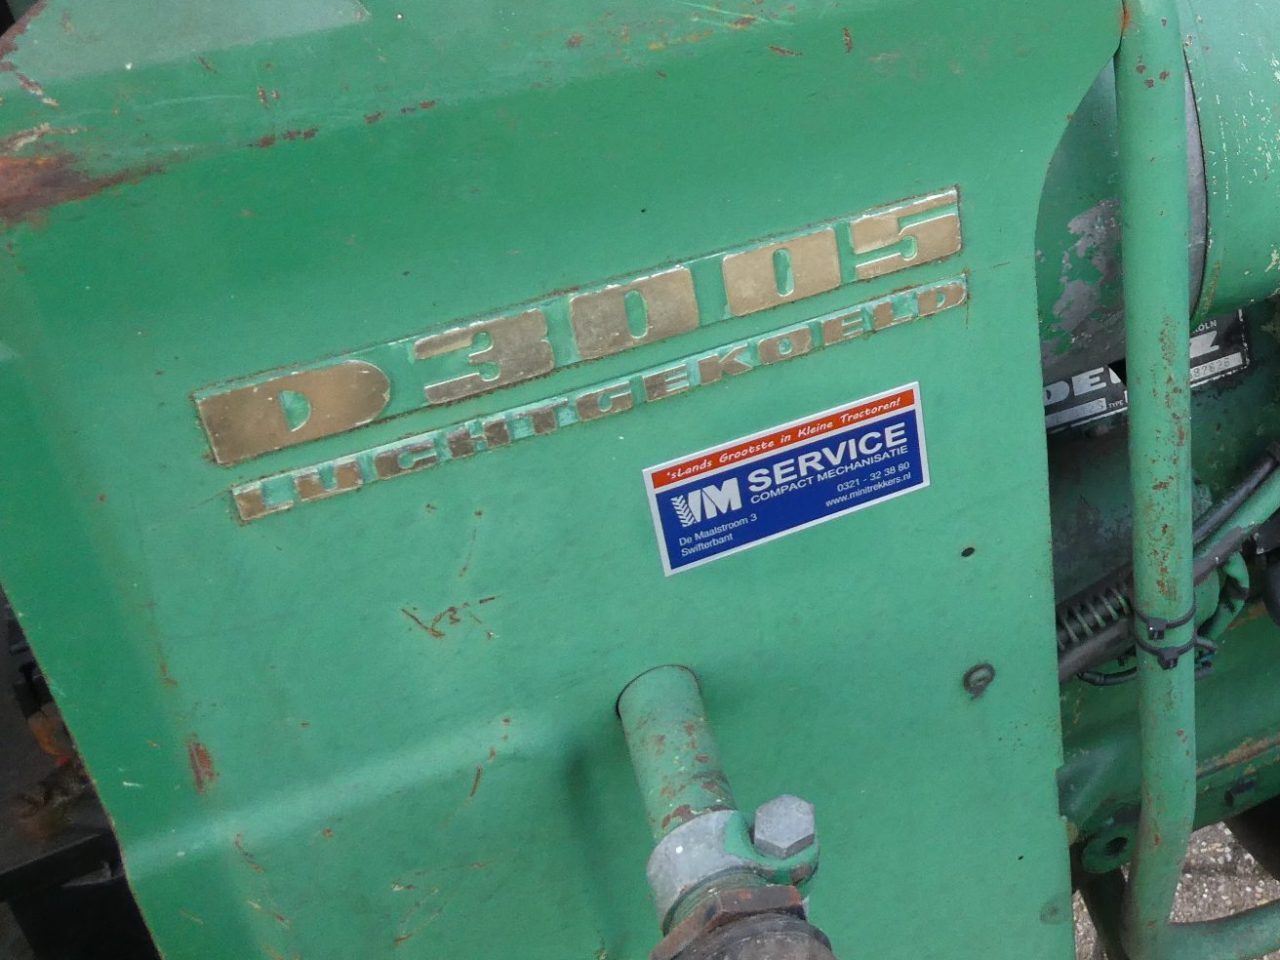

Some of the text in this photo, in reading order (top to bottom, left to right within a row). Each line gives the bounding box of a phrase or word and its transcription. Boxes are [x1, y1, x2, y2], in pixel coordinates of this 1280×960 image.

[231, 276, 967, 521] LUCHTGEKOELD
[719, 439, 775, 463] Grootste
[780, 434, 791, 444] in
[798, 421, 833, 438] Kleine
[840, 397, 901, 423] Tractoren!
[747, 422, 908, 492] SERVICE
[750, 444, 909, 504] COMPACT MECHANISATIE
[837, 478, 860, 492] 0321
[870, 471, 881, 481] 32
[884, 465, 896, 476] 38
[898, 461, 910, 471] 80
[825, 472, 912, 507] www.minitrekkers.nl
[679, 513, 758, 546] De Maalstroom 3
[681, 533, 733, 558] Swifterbant
